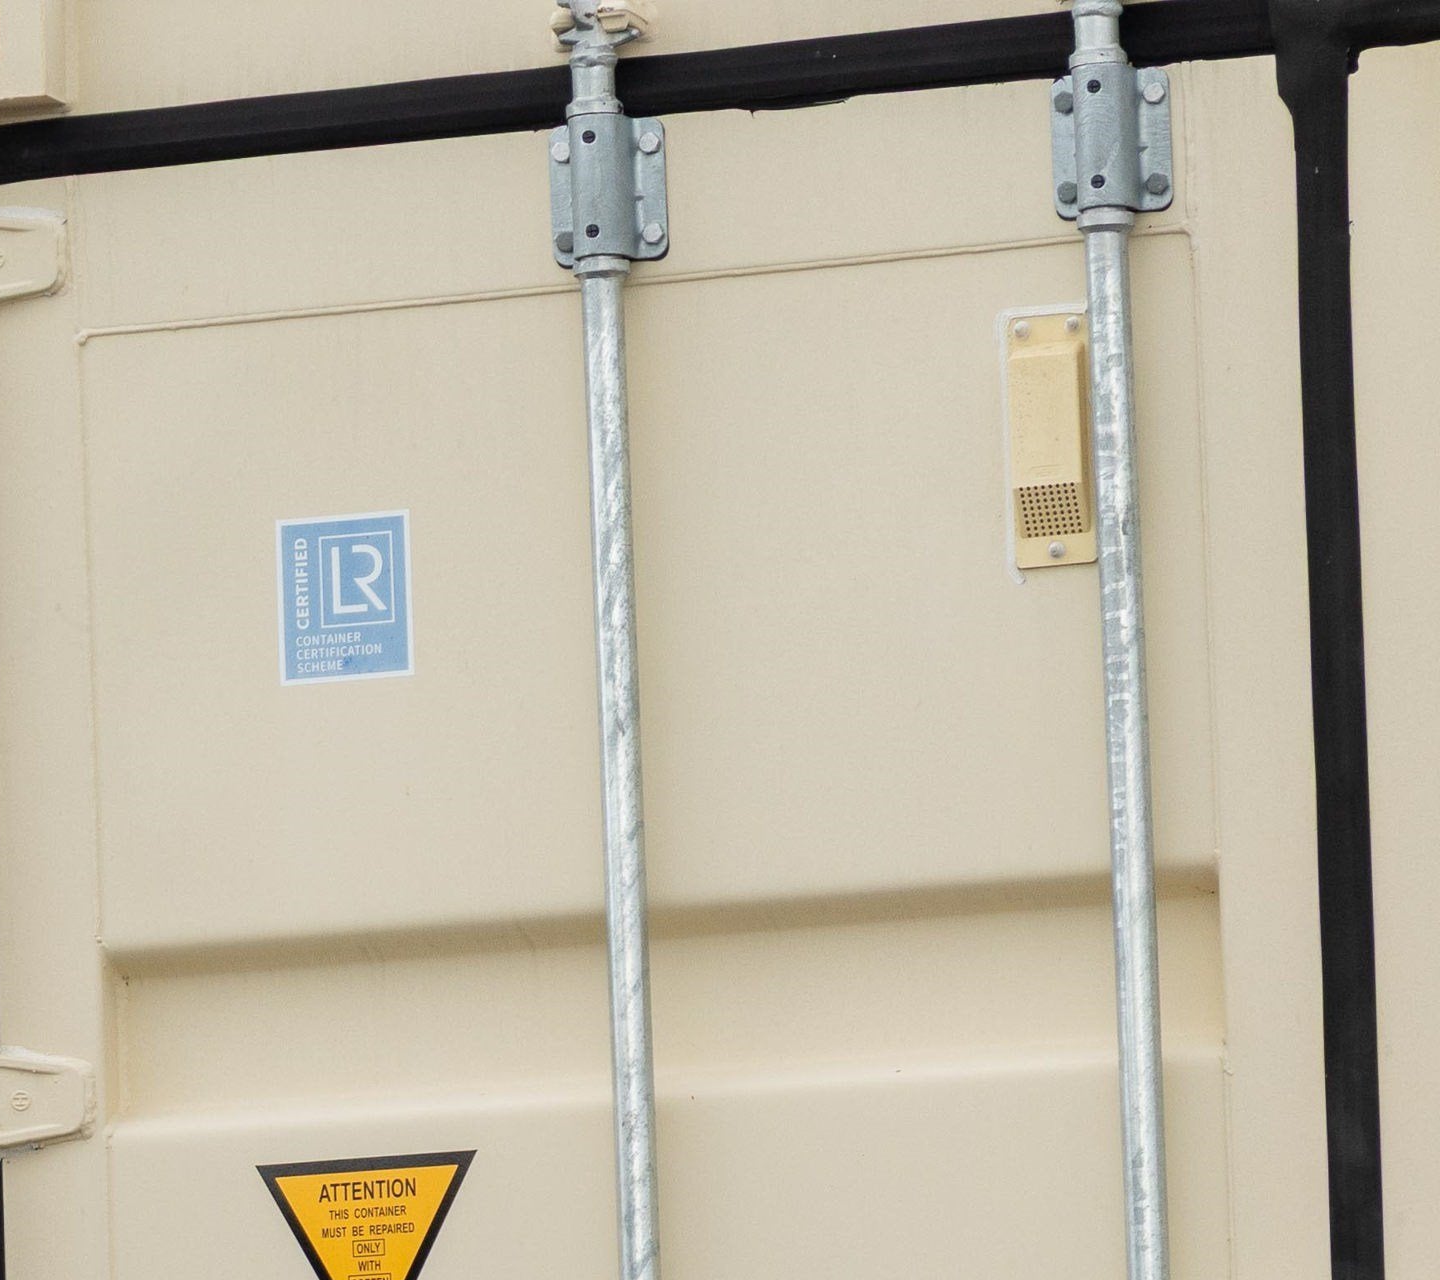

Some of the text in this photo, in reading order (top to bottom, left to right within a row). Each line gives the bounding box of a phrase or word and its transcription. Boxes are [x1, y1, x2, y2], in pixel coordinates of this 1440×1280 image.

[294, 538, 310, 629] CERTIFIED
[331, 543, 387, 615] LR
[296, 632, 362, 647] CONTAINER
[296, 643, 382, 660] CERTIFICATION
[297, 659, 343, 673] SCHEME
[318, 1177, 417, 1203] ATTENTION
[329, 1205, 406, 1220] THIS CONTAINER
[321, 1222, 415, 1239] MUST BE REPAIRED
[356, 1242, 381, 1255] ONLY
[358, 1260, 381, 1272] WITH
